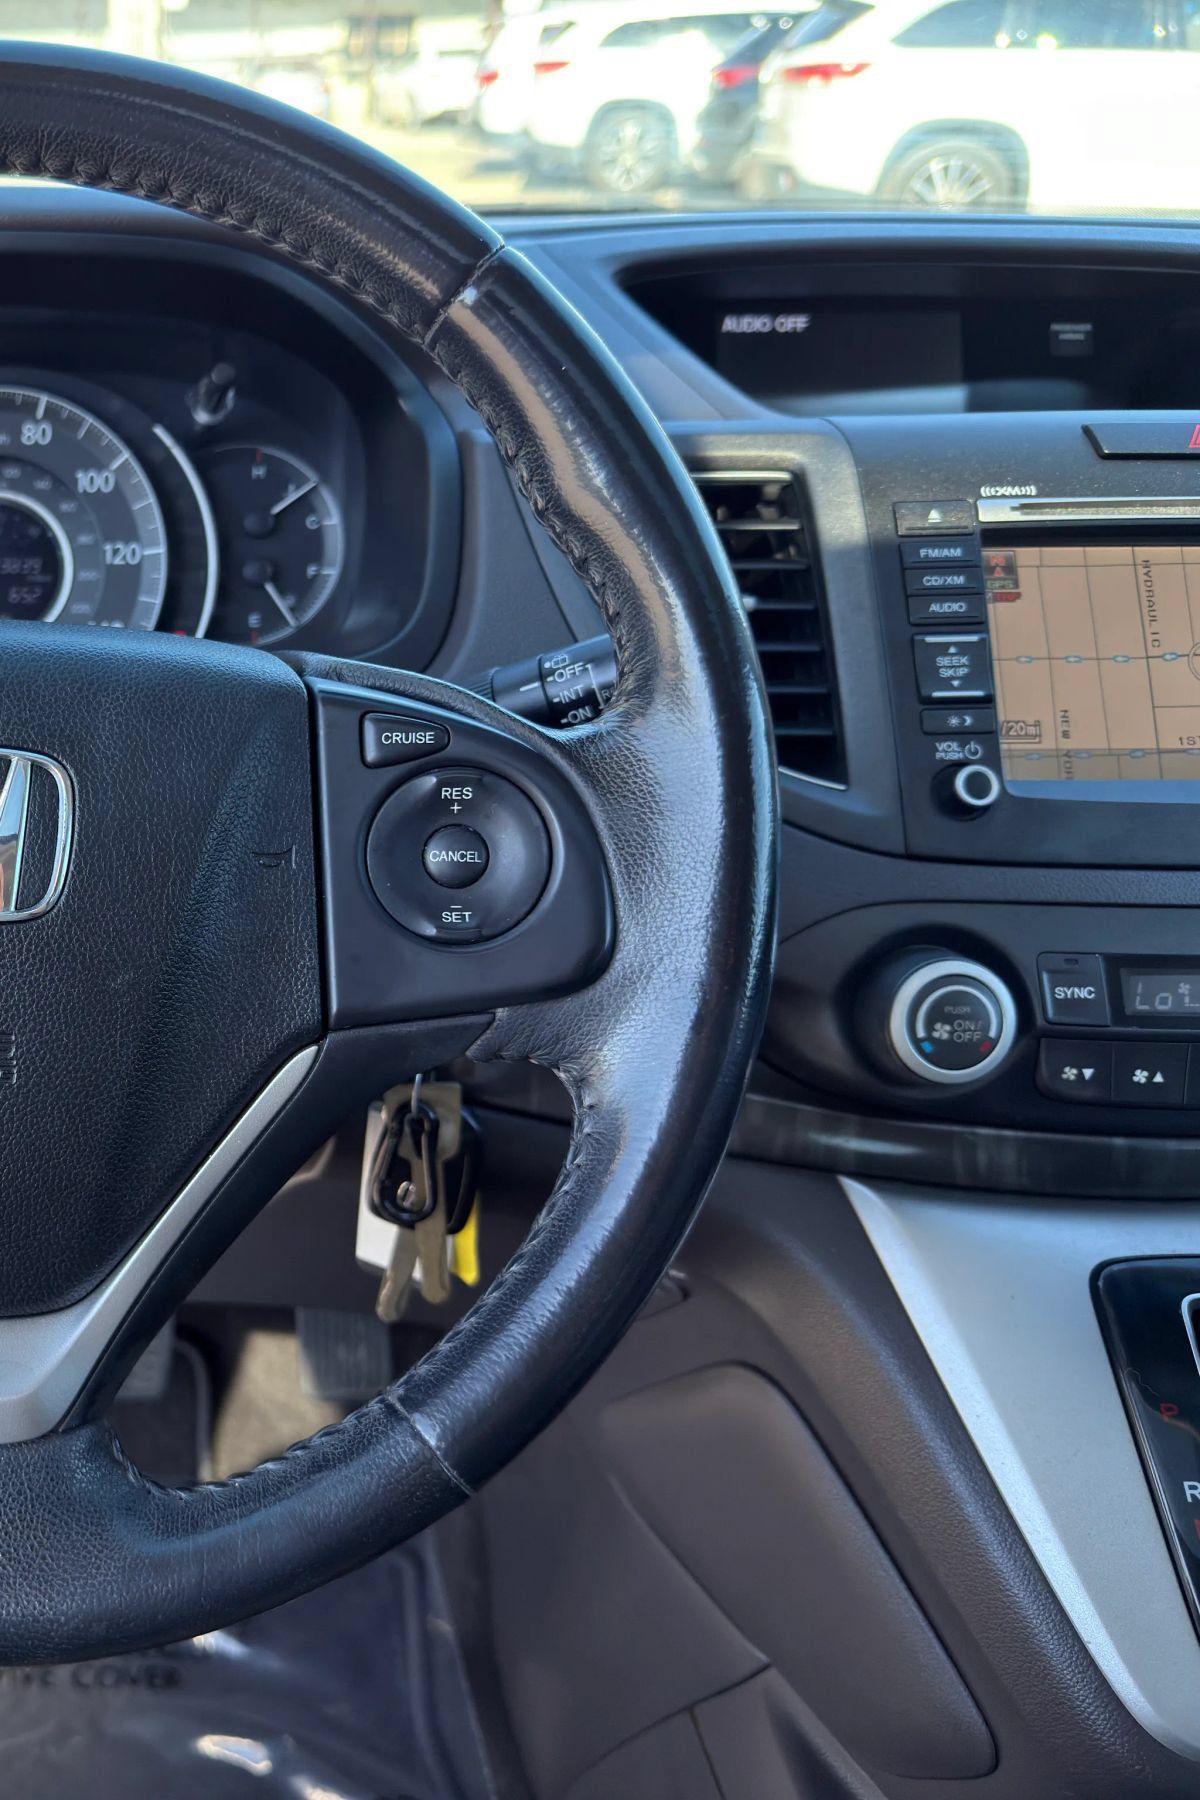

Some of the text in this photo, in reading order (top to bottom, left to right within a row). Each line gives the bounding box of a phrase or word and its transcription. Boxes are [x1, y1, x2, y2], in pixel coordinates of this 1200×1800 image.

[721, 313, 811, 333] AUDIO OFF
[20, 420, 52, 446] 80
[75, 468, 116, 493] 100
[103, 541, 143, 565] 120
[920, 547, 962, 559] FM/AM
[923, 575, 965, 586] CD/XM
[928, 602, 968, 613] AUDIO
[935, 656, 969, 667] SEEK
[554, 662, 584, 683] OFF
[938, 667, 969, 678] SKIP
[559, 684, 583, 704] INT
[567, 705, 593, 724] ON
[381, 732, 435, 745] CRUISE
[934, 742, 961, 751] VOL
[935, 751, 964, 760] PUSH
[441, 787, 473, 800] RES
[429, 850, 482, 863] CANCEL
[441, 911, 472, 923] SET
[1054, 986, 1096, 999] SYNC
[953, 1031, 982, 1042] OFF
[1183, 1481, 1200, 1503] R
